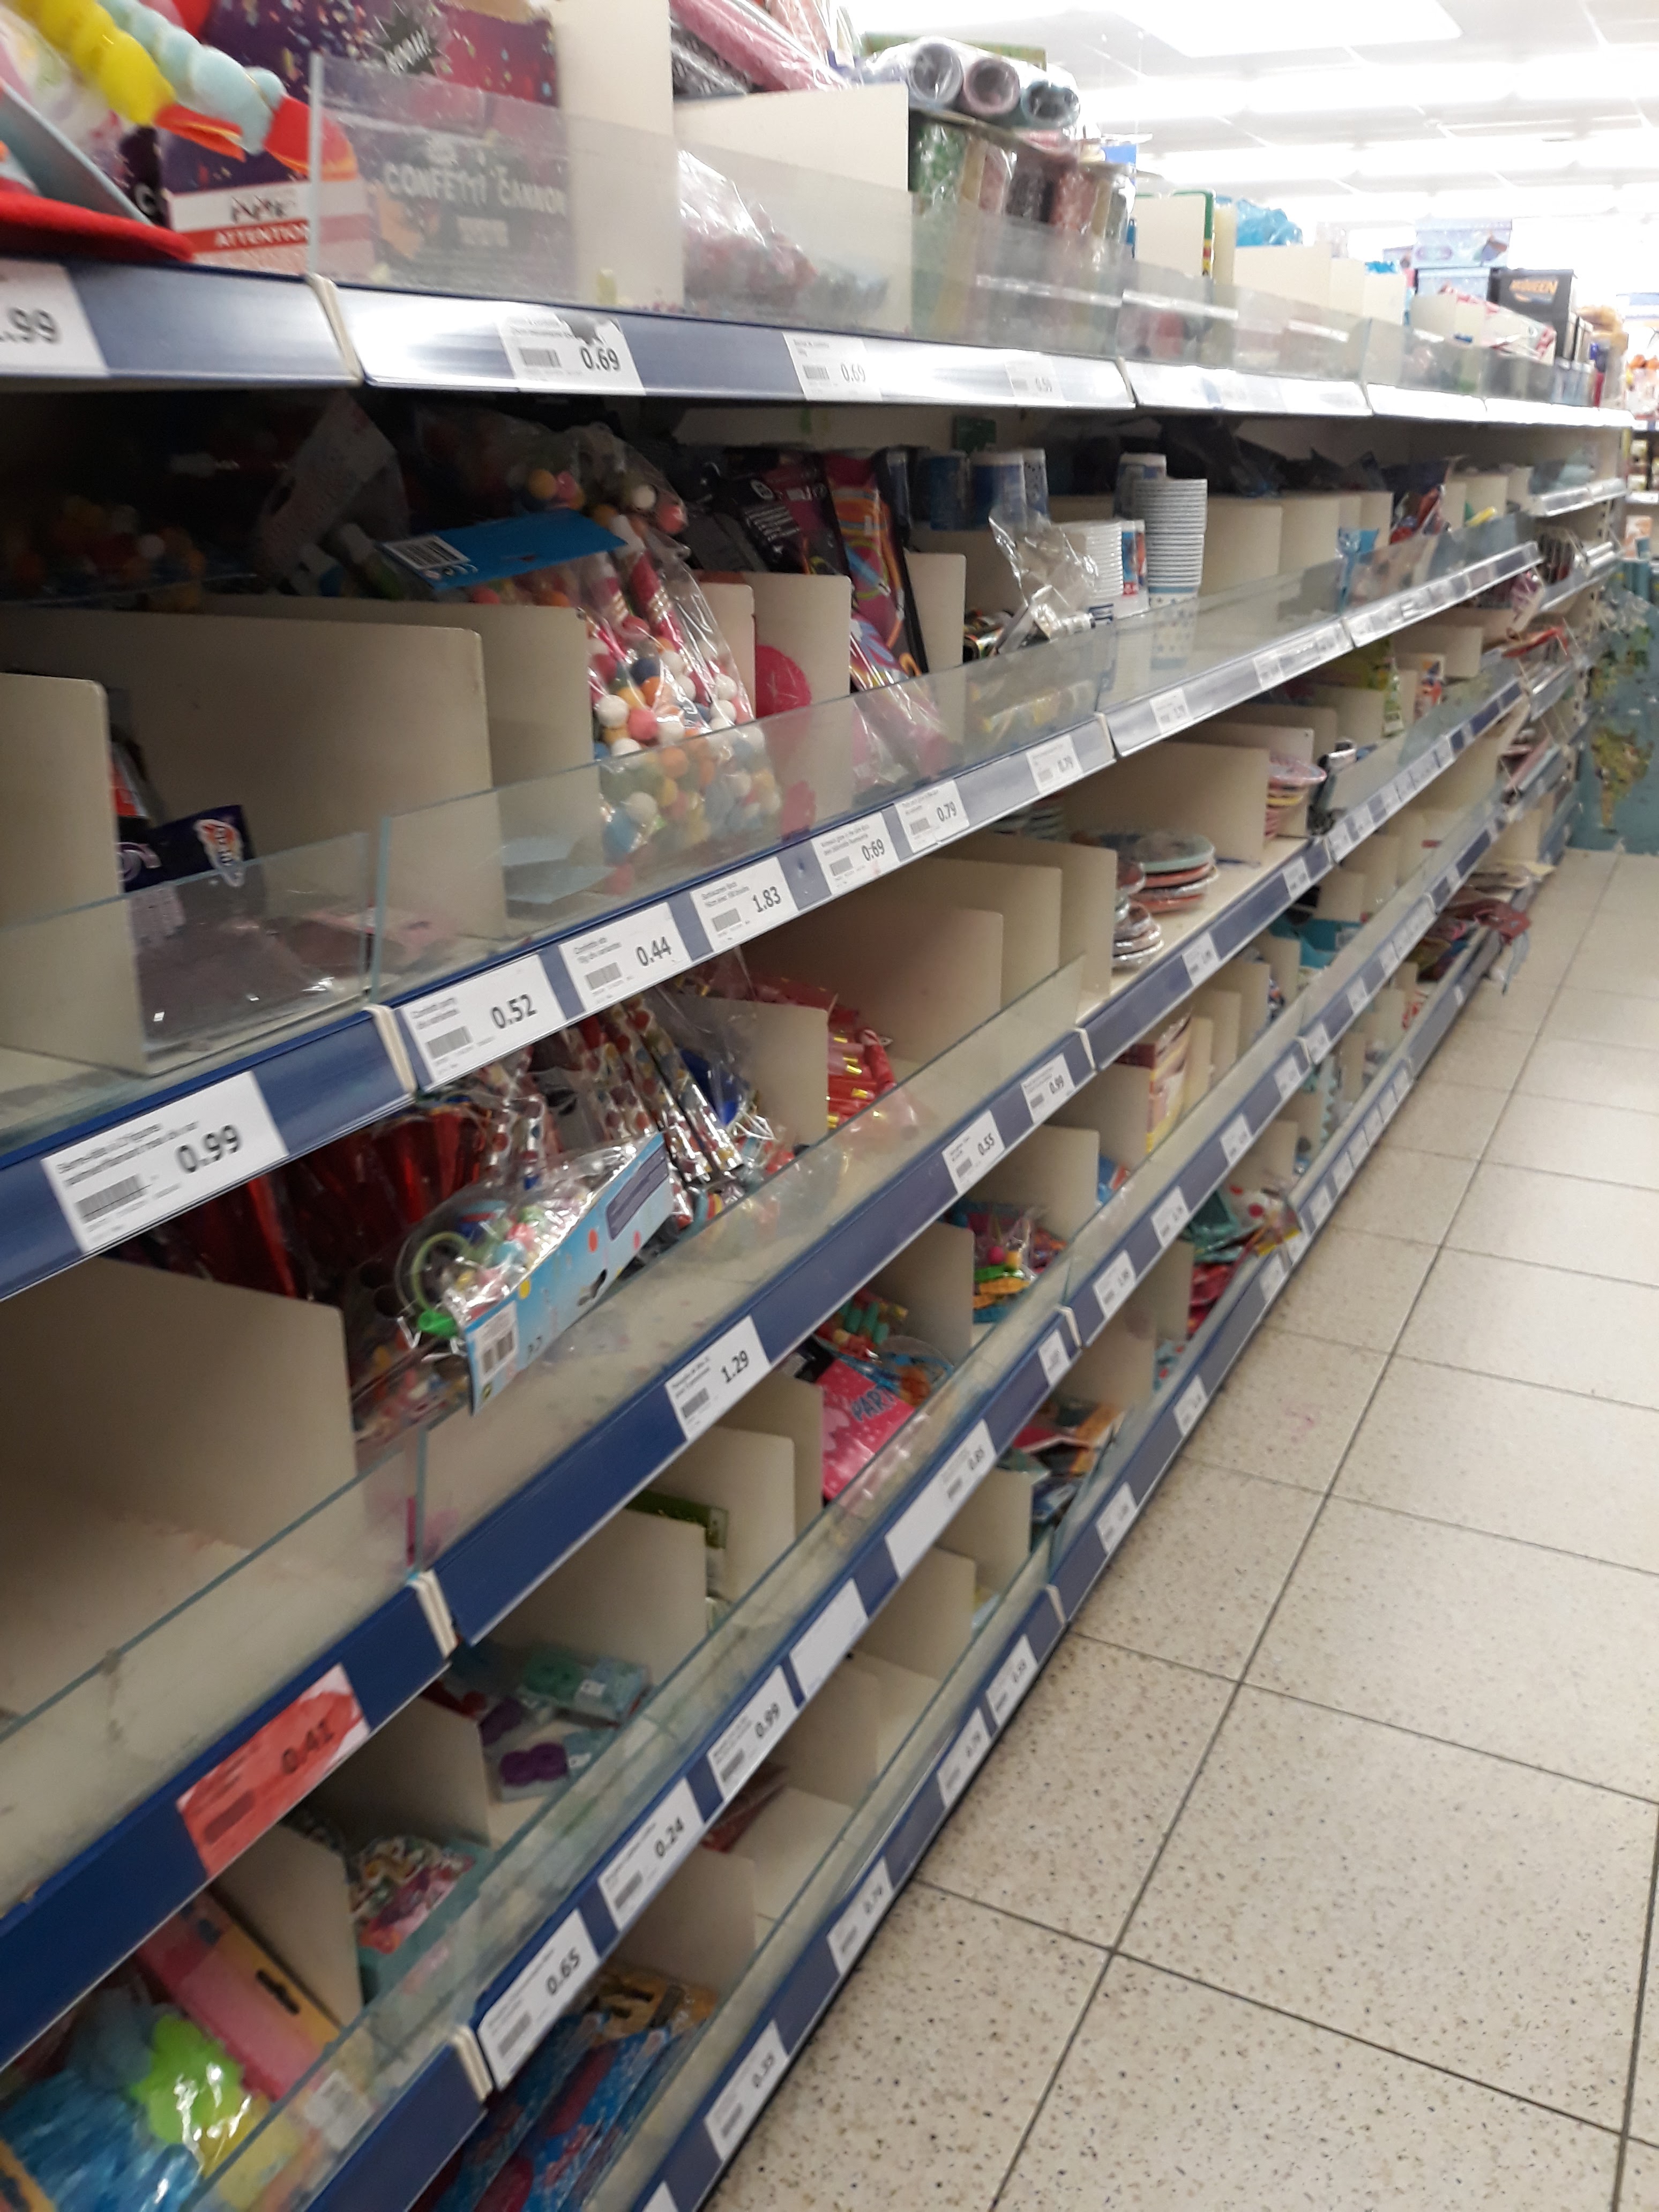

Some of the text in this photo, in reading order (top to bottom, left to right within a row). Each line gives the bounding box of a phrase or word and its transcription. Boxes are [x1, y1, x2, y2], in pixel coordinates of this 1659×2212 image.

[0, 307, 59, 343] .99
[579, 346, 621, 371] 0.69
[862, 838, 885, 861] 0.69
[752, 886, 782, 913] 1.83
[636, 936, 672, 967] 0.44
[491, 993, 537, 1029] 0.52
[176, 1124, 241, 1174] 0.99
[721, 1350, 749, 1384] 1.29
[545, 1947, 581, 1996] 0.65
